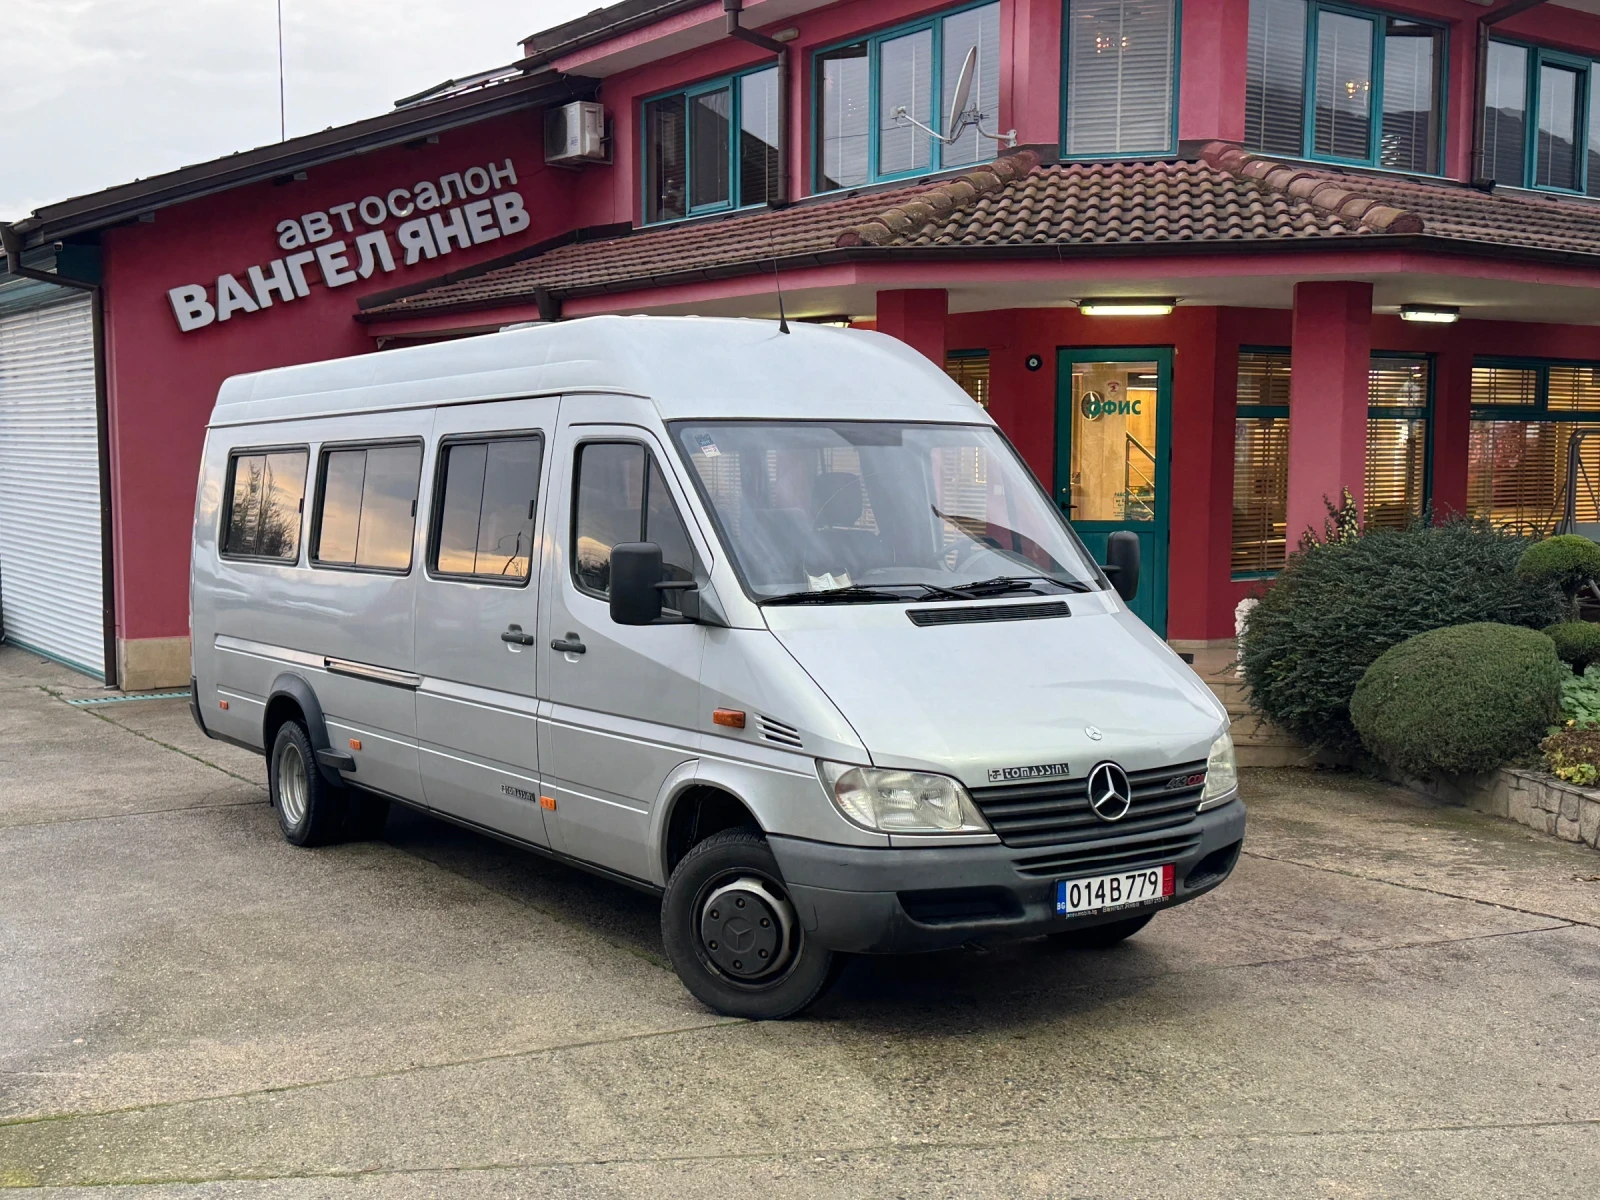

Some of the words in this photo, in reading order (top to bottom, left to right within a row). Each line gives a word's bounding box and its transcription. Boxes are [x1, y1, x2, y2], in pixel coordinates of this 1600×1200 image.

[276, 158, 518, 250] автосалон
[168, 230, 397, 332] ВАНГЕЛ
[397, 191, 531, 266] ЯНЕВ
[1088, 400, 1142, 417] ОФИС
[1057, 902, 1066, 910] BG
